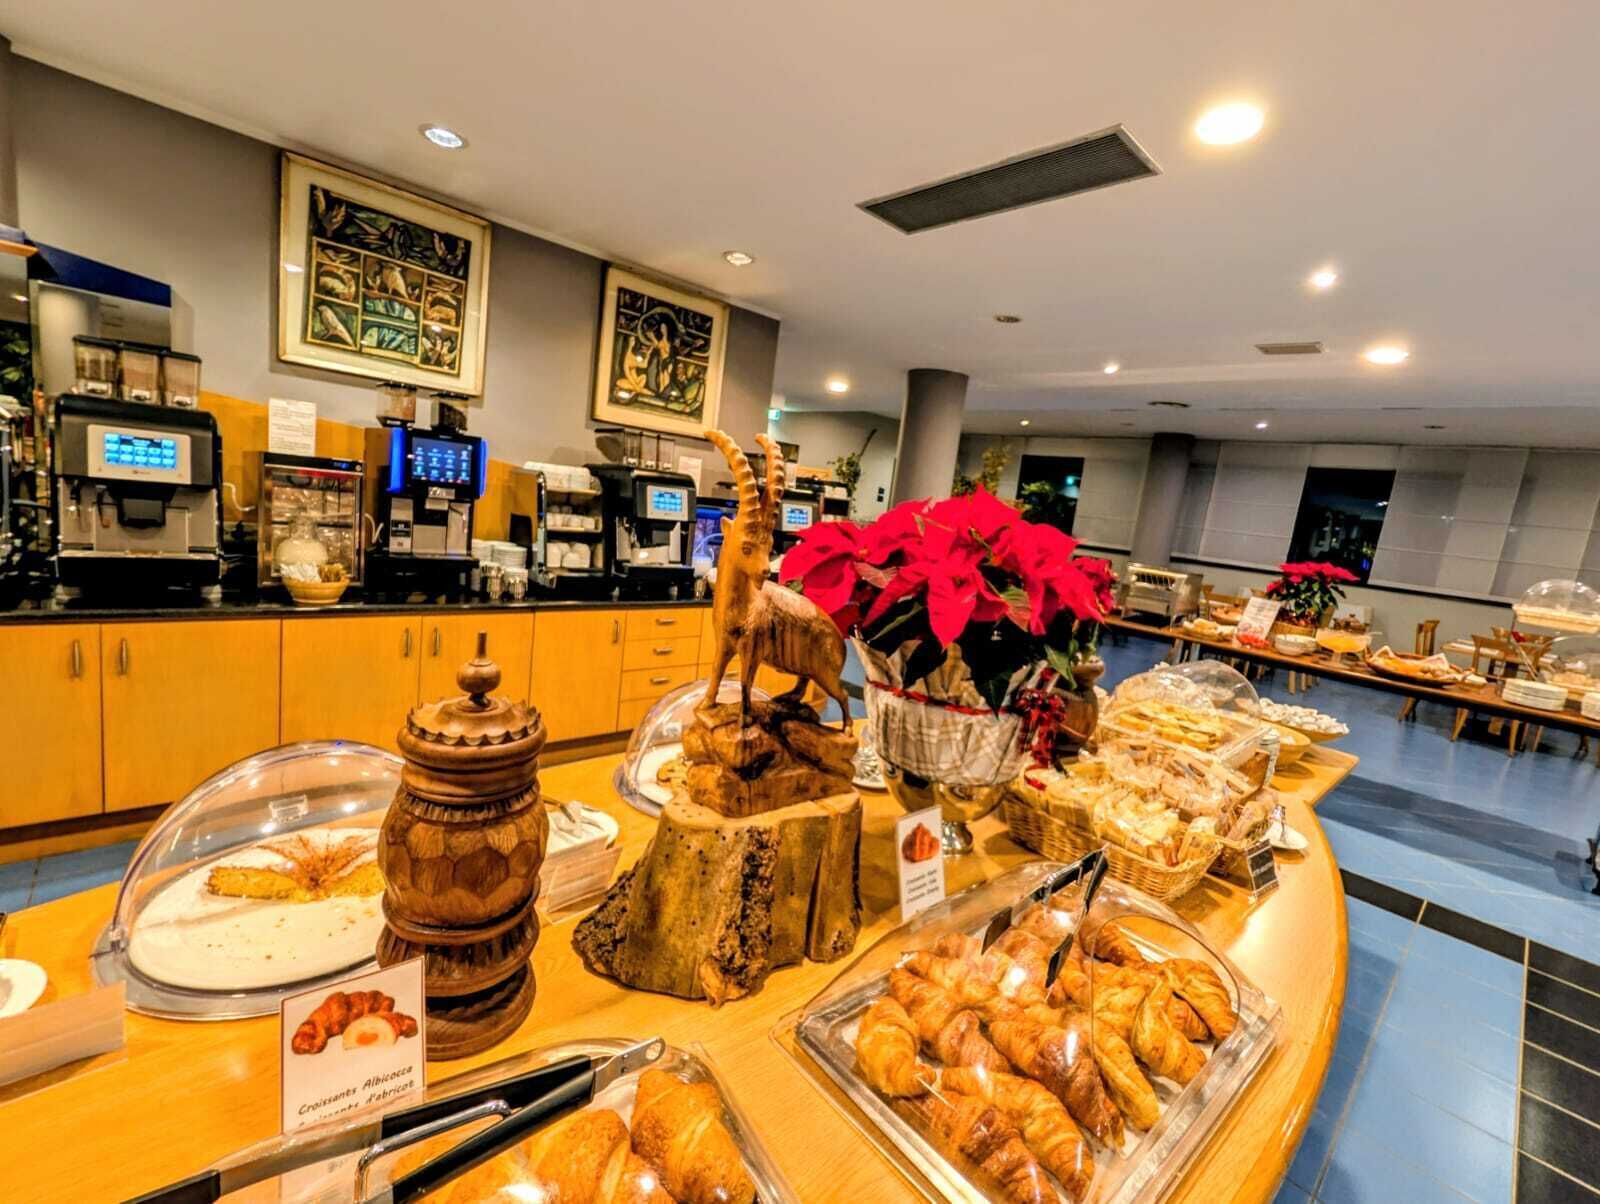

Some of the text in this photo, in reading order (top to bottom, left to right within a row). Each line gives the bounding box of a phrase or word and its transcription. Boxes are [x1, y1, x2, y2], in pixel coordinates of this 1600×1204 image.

[298, 1065, 413, 1116] Croissants Albicocca
[365, 1079, 415, 1104] d'abricot
